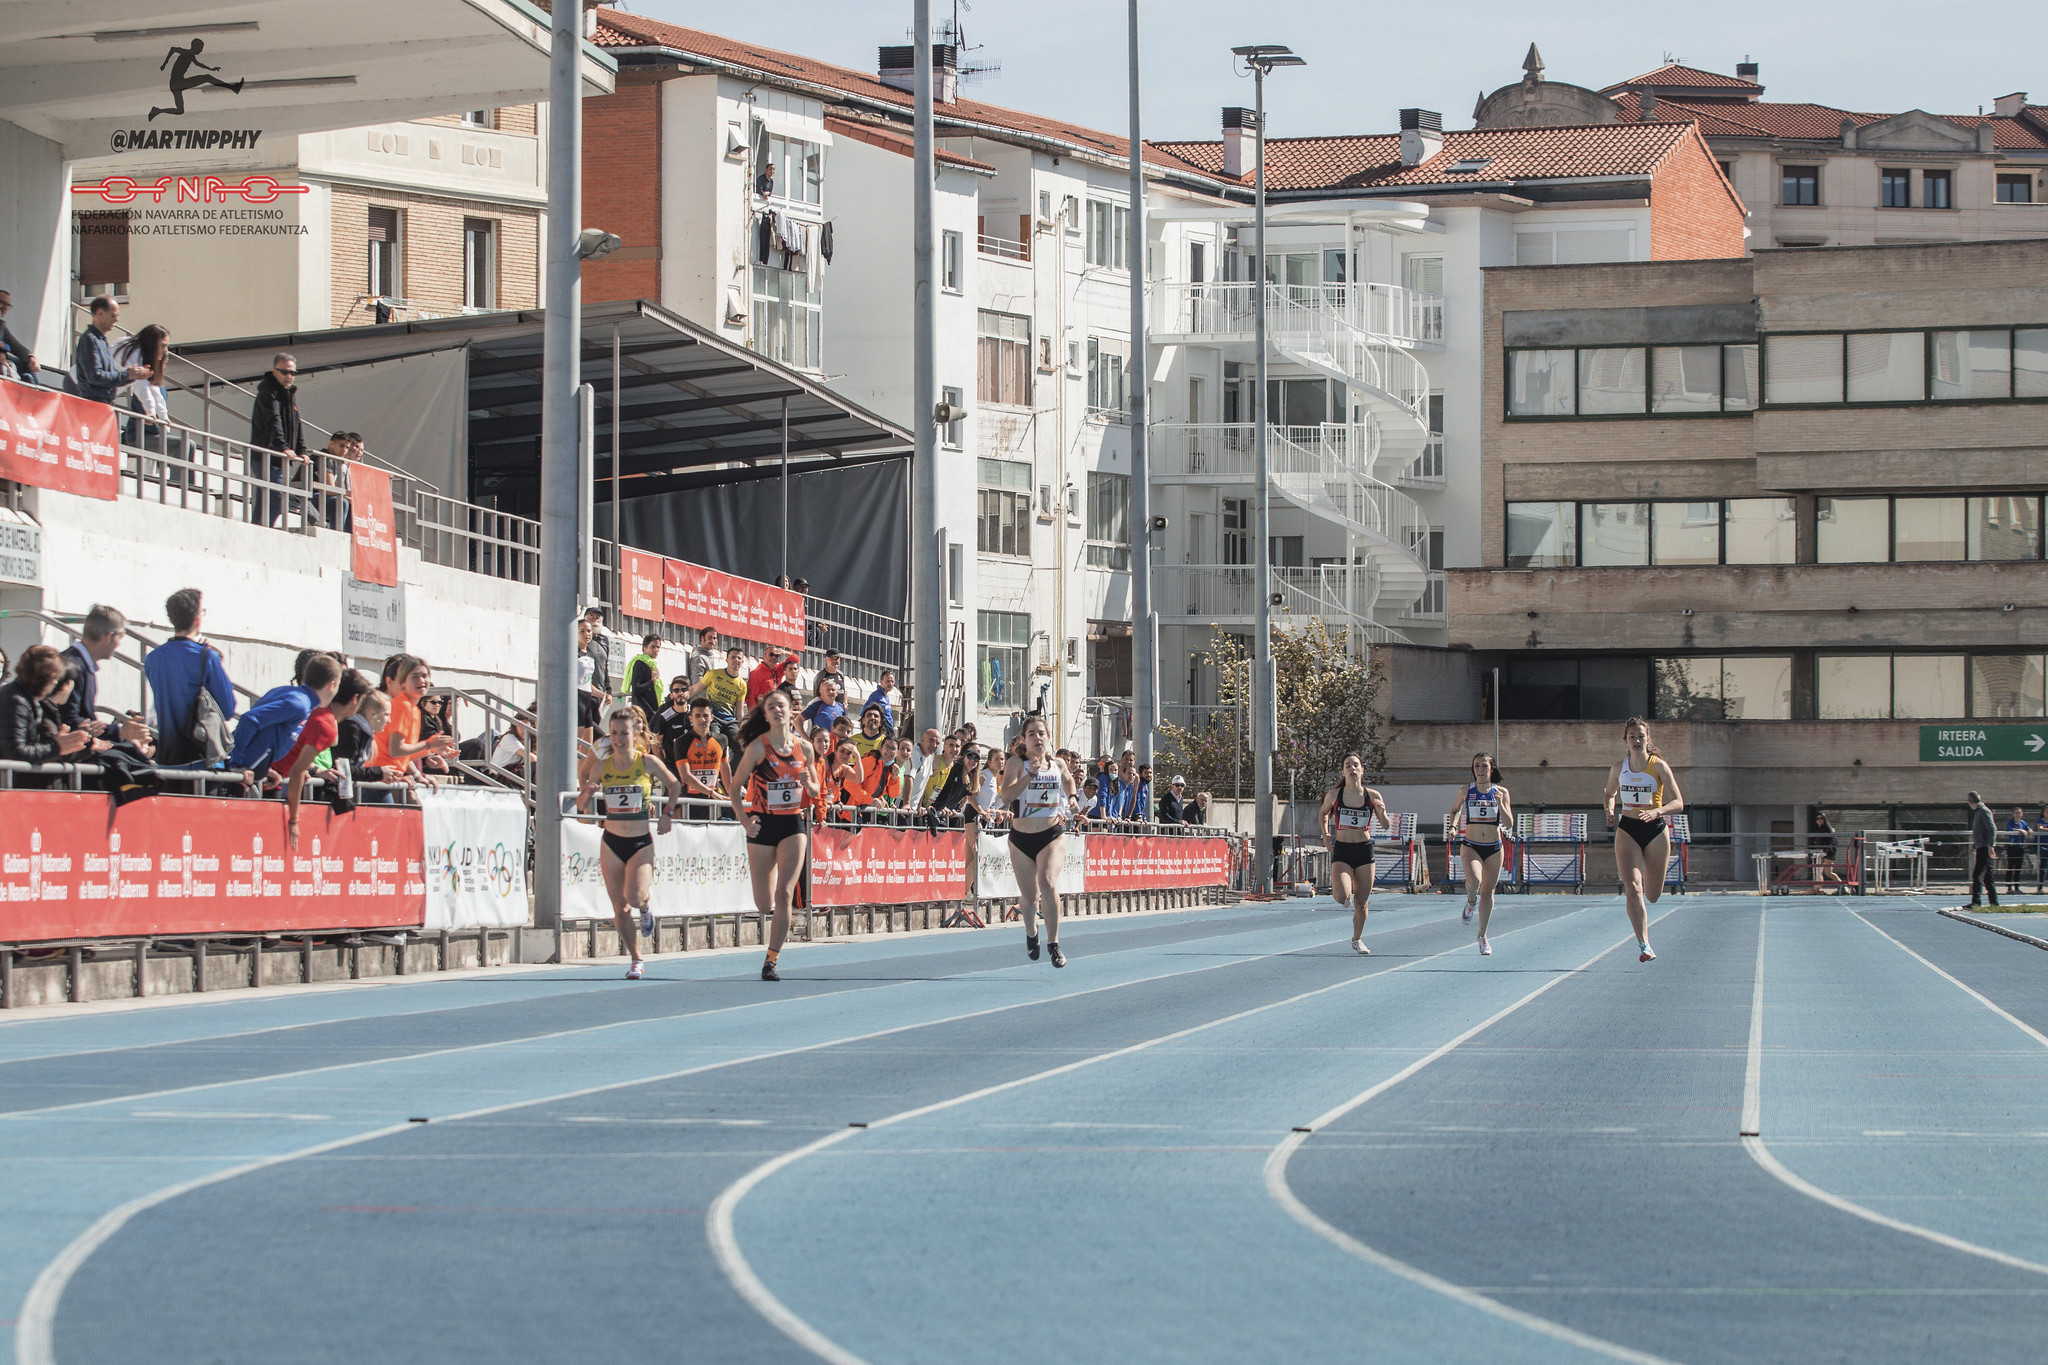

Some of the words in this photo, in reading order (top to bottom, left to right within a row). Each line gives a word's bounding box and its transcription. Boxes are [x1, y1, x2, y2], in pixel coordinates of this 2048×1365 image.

[1938, 730, 1987, 740] IRTEERA
[1938, 746, 1984, 757] SALIDA
[701, 776, 707, 785] 6
[619, 795, 629, 806] 2
[782, 791, 791, 802] 6
[1041, 790, 1048, 801] 4
[1633, 792, 1638, 802] 1
[1480, 808, 1487, 816] 5
[1351, 817, 1358, 825] 3
